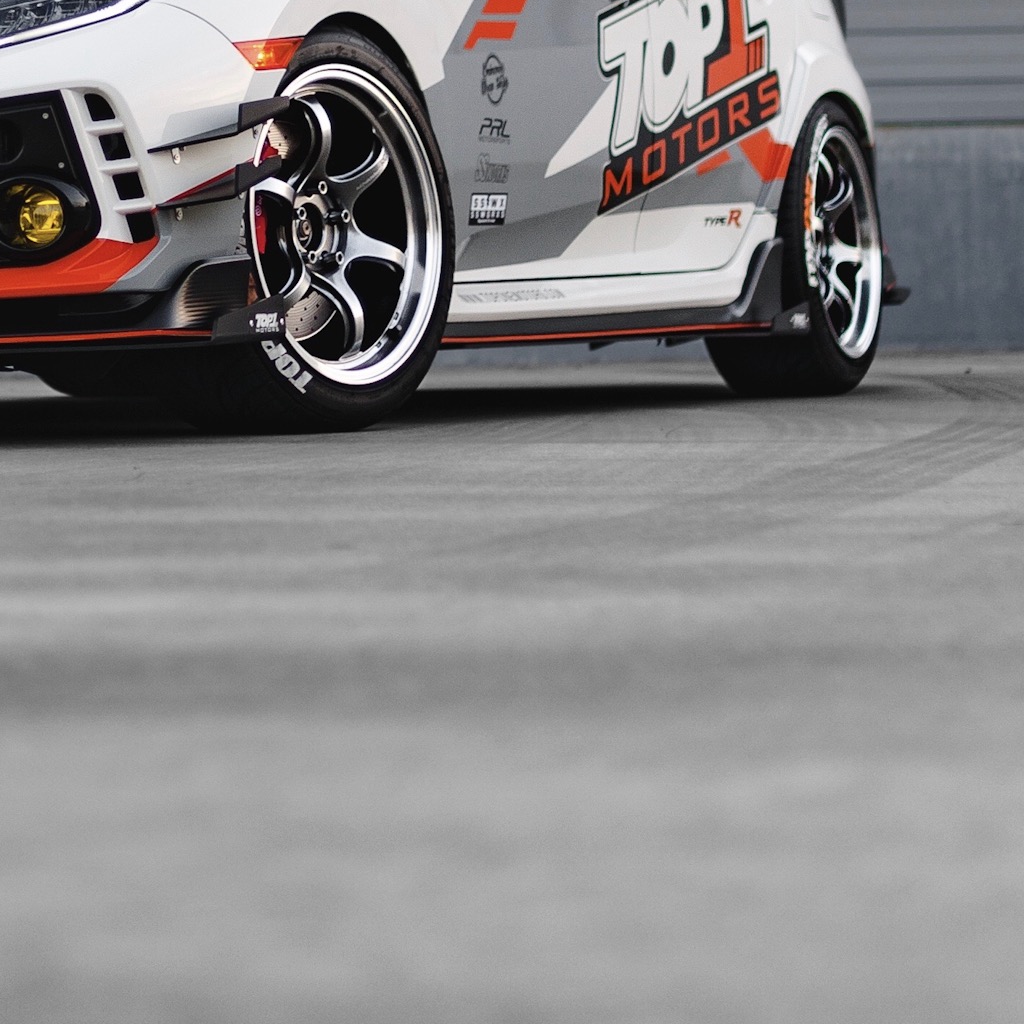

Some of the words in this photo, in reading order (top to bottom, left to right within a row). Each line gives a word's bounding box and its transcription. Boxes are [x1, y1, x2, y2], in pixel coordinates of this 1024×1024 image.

[479, 117, 510, 138] PRL
[602, 75, 780, 207] MOTORS
[704, 217, 727, 226] TYPE
[727, 208, 742, 228] R
[255, 313, 279, 327] TOP1
[261, 340, 313, 394] TOP
